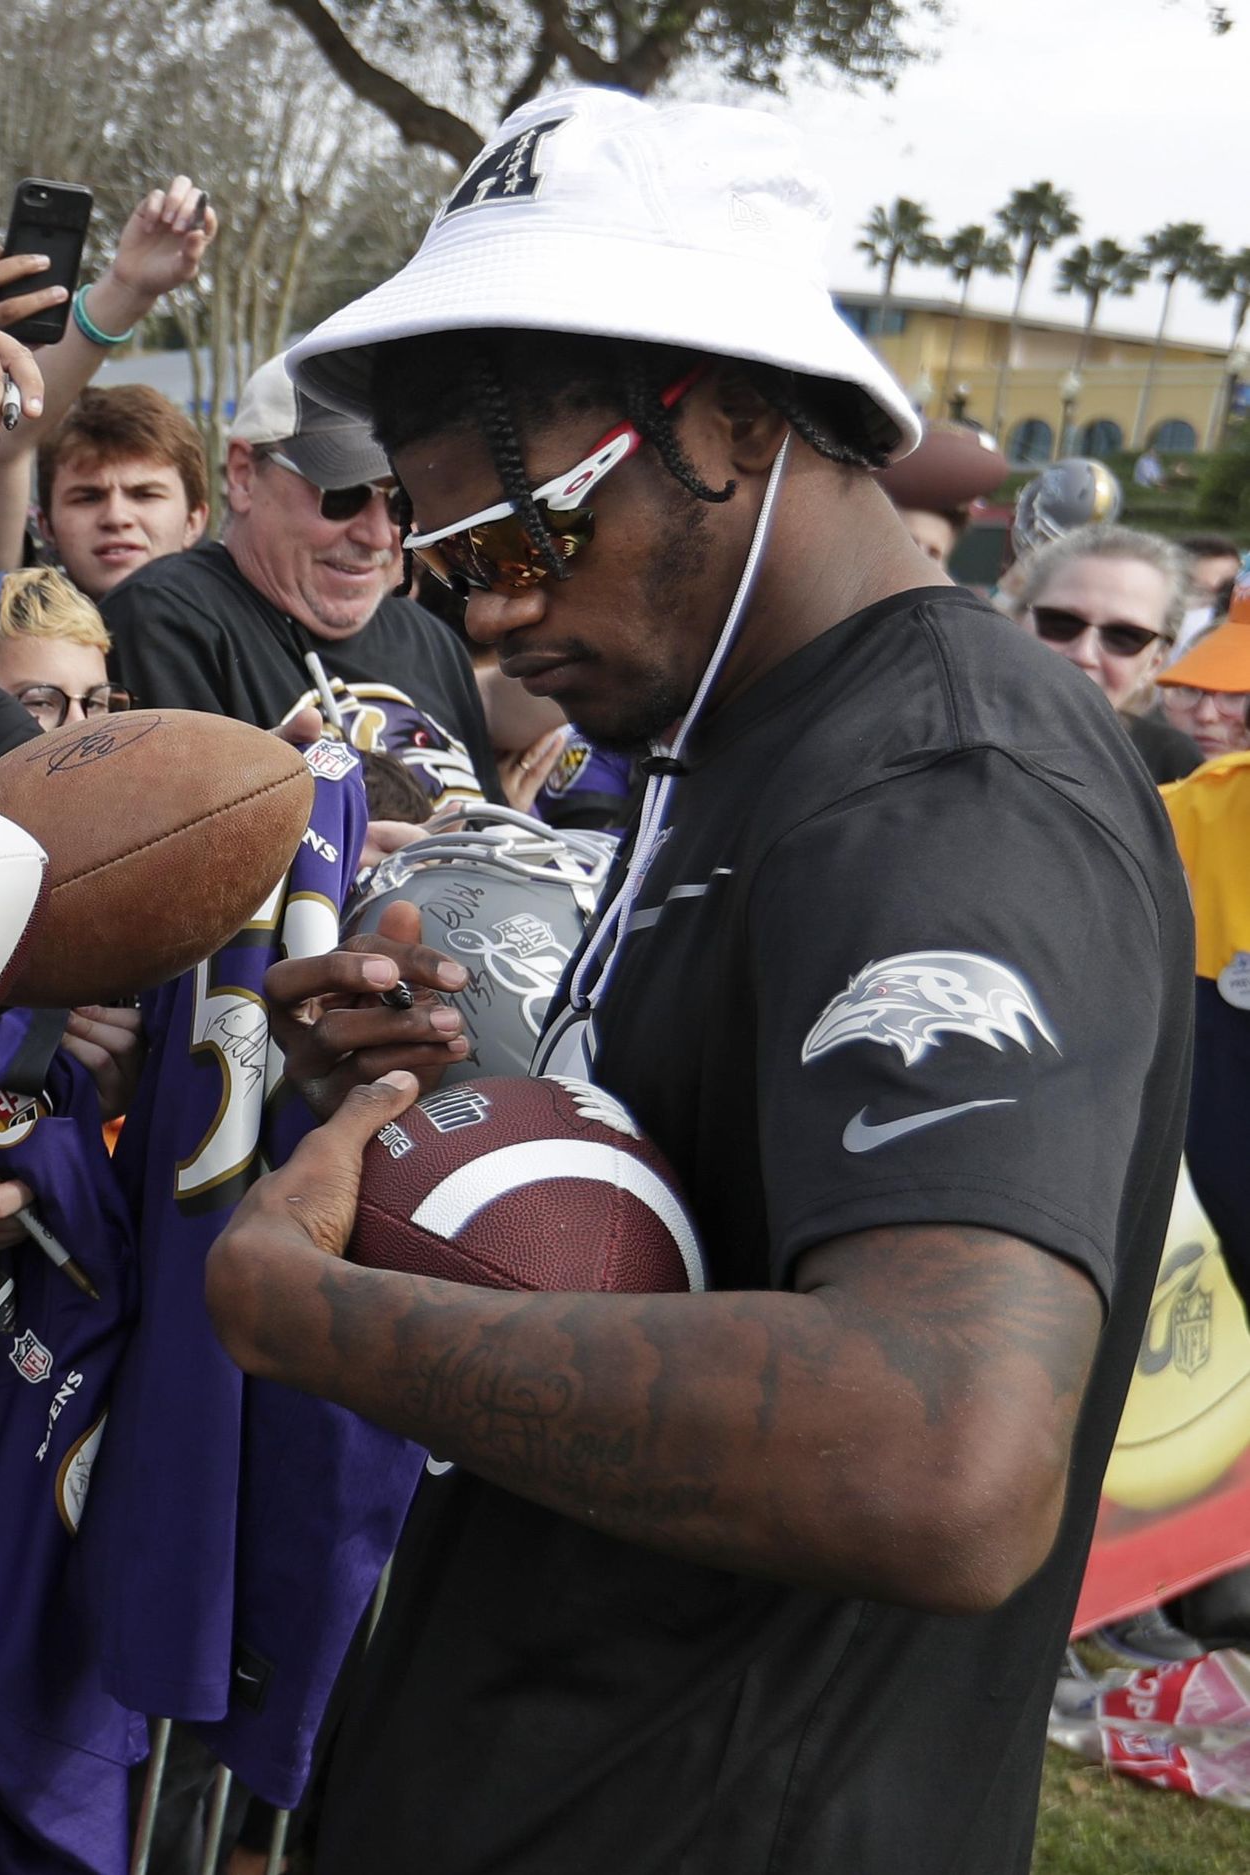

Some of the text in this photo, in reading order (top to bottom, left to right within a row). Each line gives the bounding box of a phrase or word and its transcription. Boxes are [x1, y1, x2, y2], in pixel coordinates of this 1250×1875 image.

[309, 750, 338, 774] NFL
[514, 916, 550, 945] NFL
[21, 1350, 48, 1378] NFL
